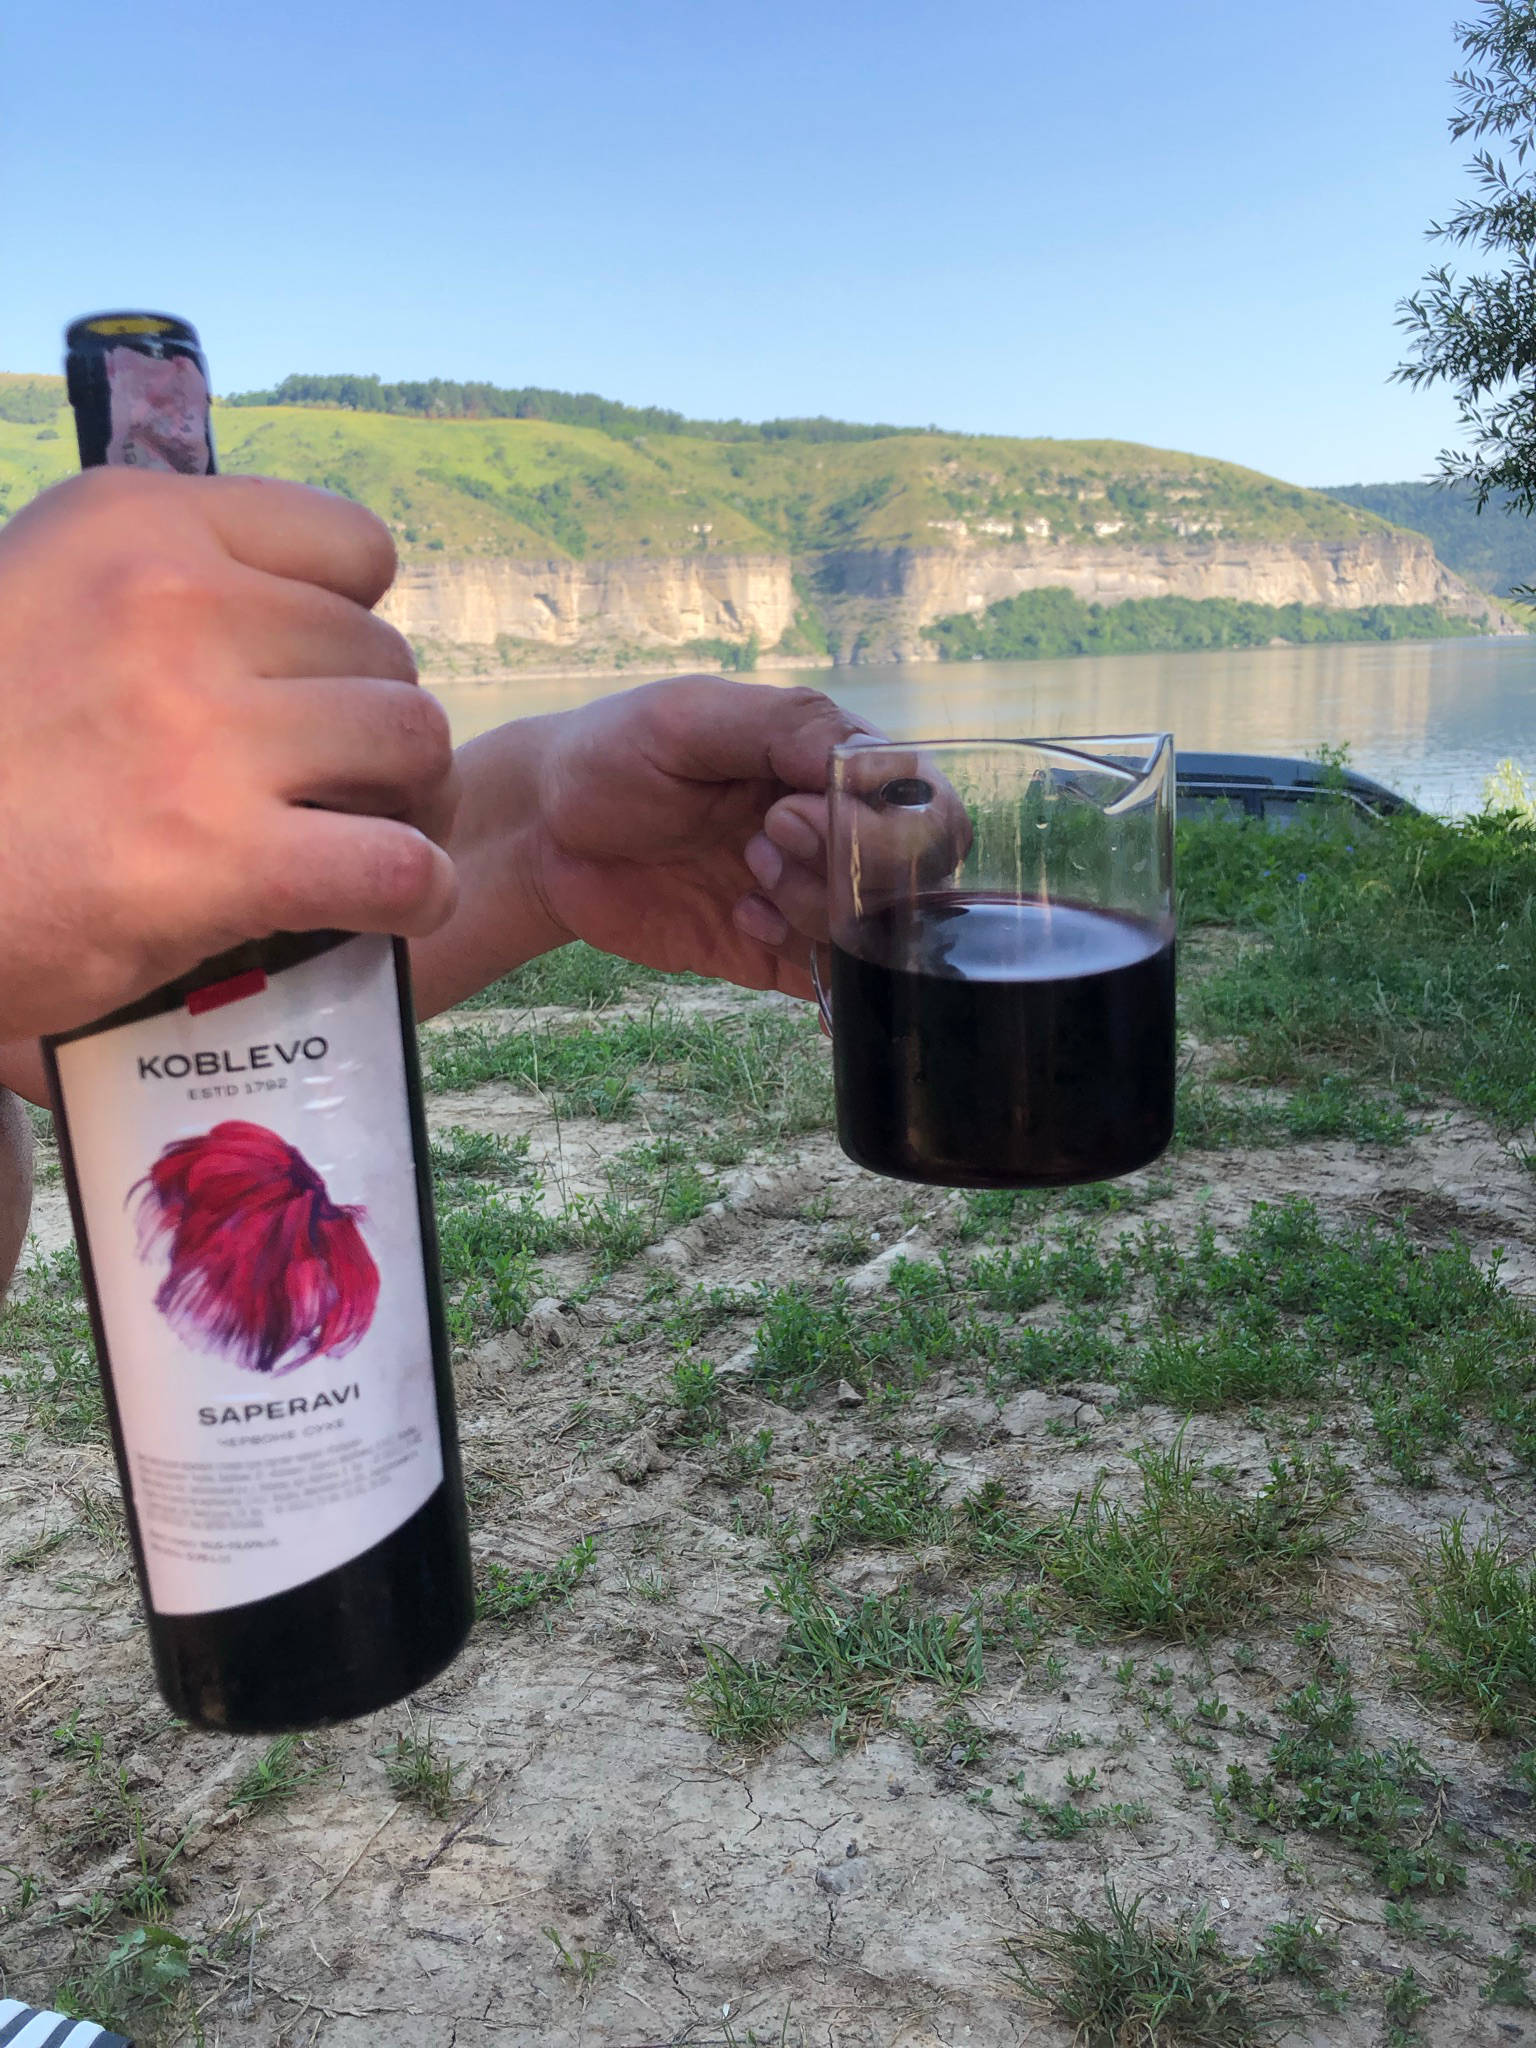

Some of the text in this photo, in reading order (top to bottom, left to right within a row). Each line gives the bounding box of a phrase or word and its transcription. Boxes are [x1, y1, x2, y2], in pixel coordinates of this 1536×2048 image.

[138, 1036, 328, 1079] KOBLEVO
[188, 1086, 239, 1100] ESTD
[198, 1382, 361, 1426] SAPERAVI
